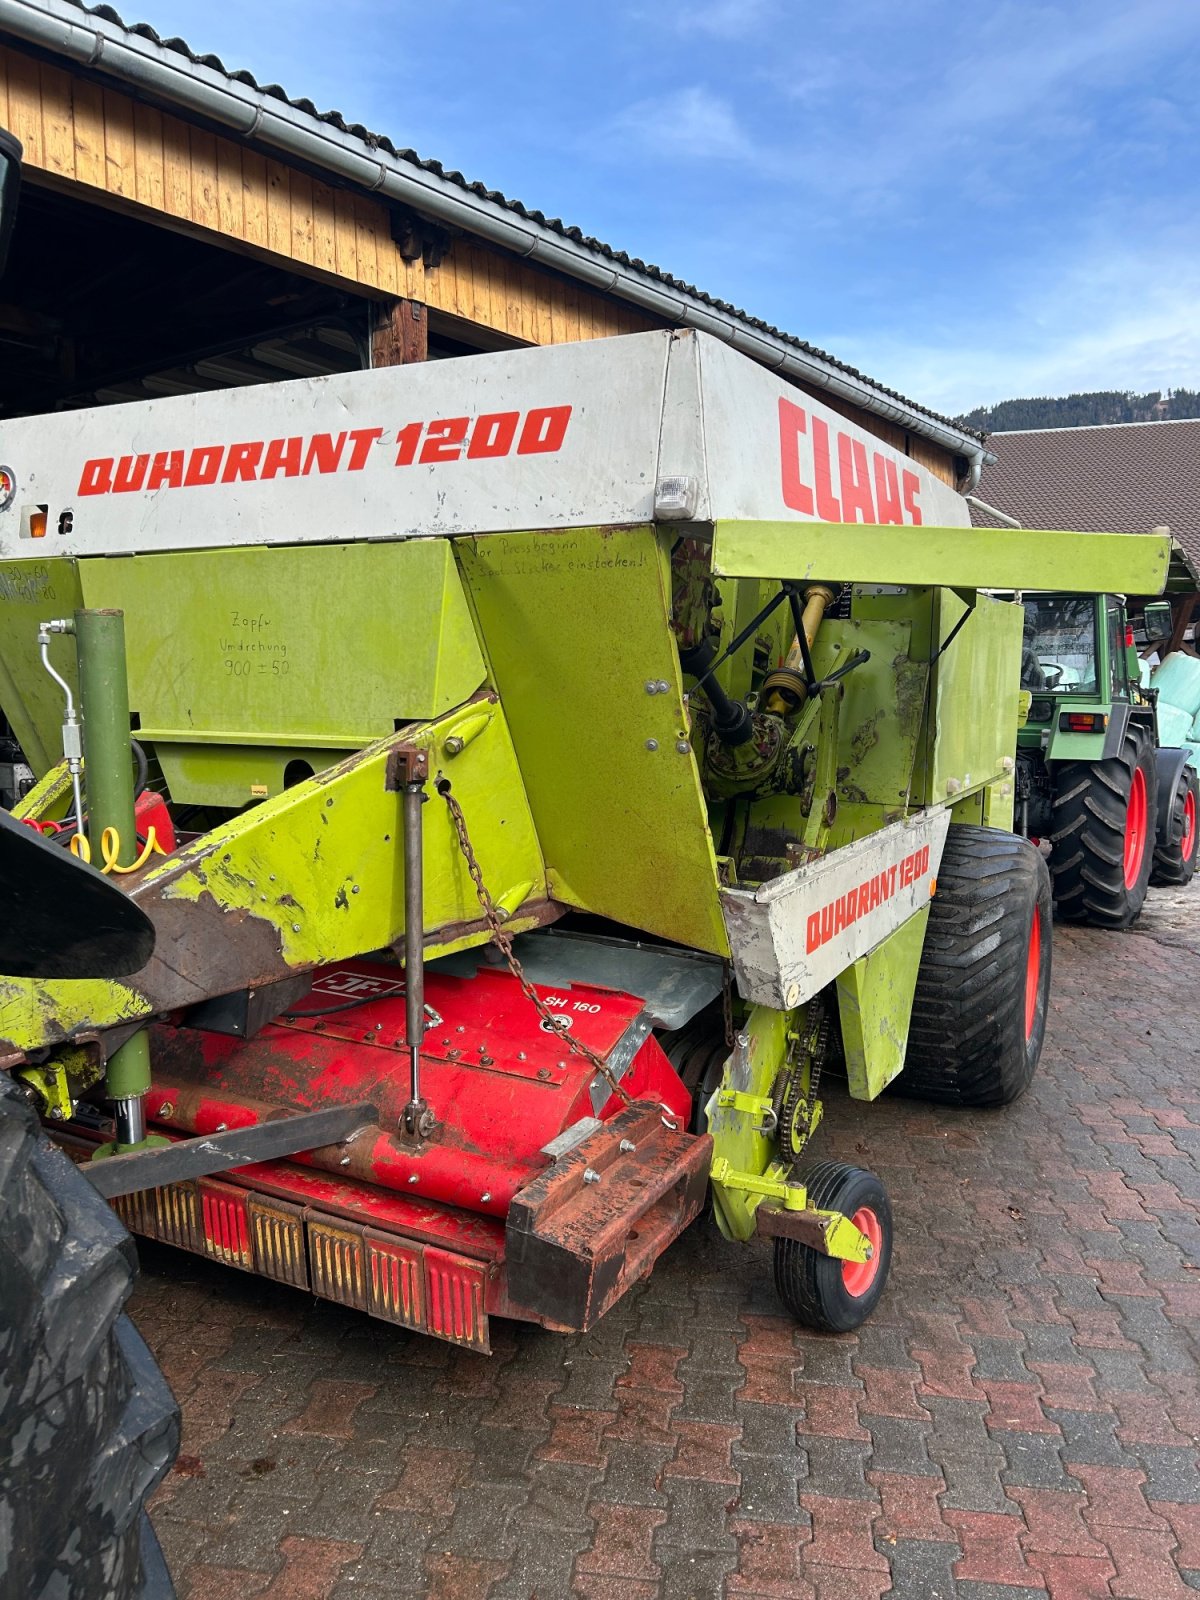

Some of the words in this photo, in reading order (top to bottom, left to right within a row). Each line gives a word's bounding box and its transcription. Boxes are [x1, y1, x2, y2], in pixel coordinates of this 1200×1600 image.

[77, 427, 384, 497] QUADRANT
[394, 404, 573, 467] 1200
[778, 396, 922, 526] CLAAS
[224, 659, 251, 676] 900
[272, 660, 290, 675] 50
[806, 864, 898, 956] QUADRANT
[899, 844, 930, 890] 1200
[542, 996, 569, 1008] SH
[572, 1001, 602, 1014] 160
